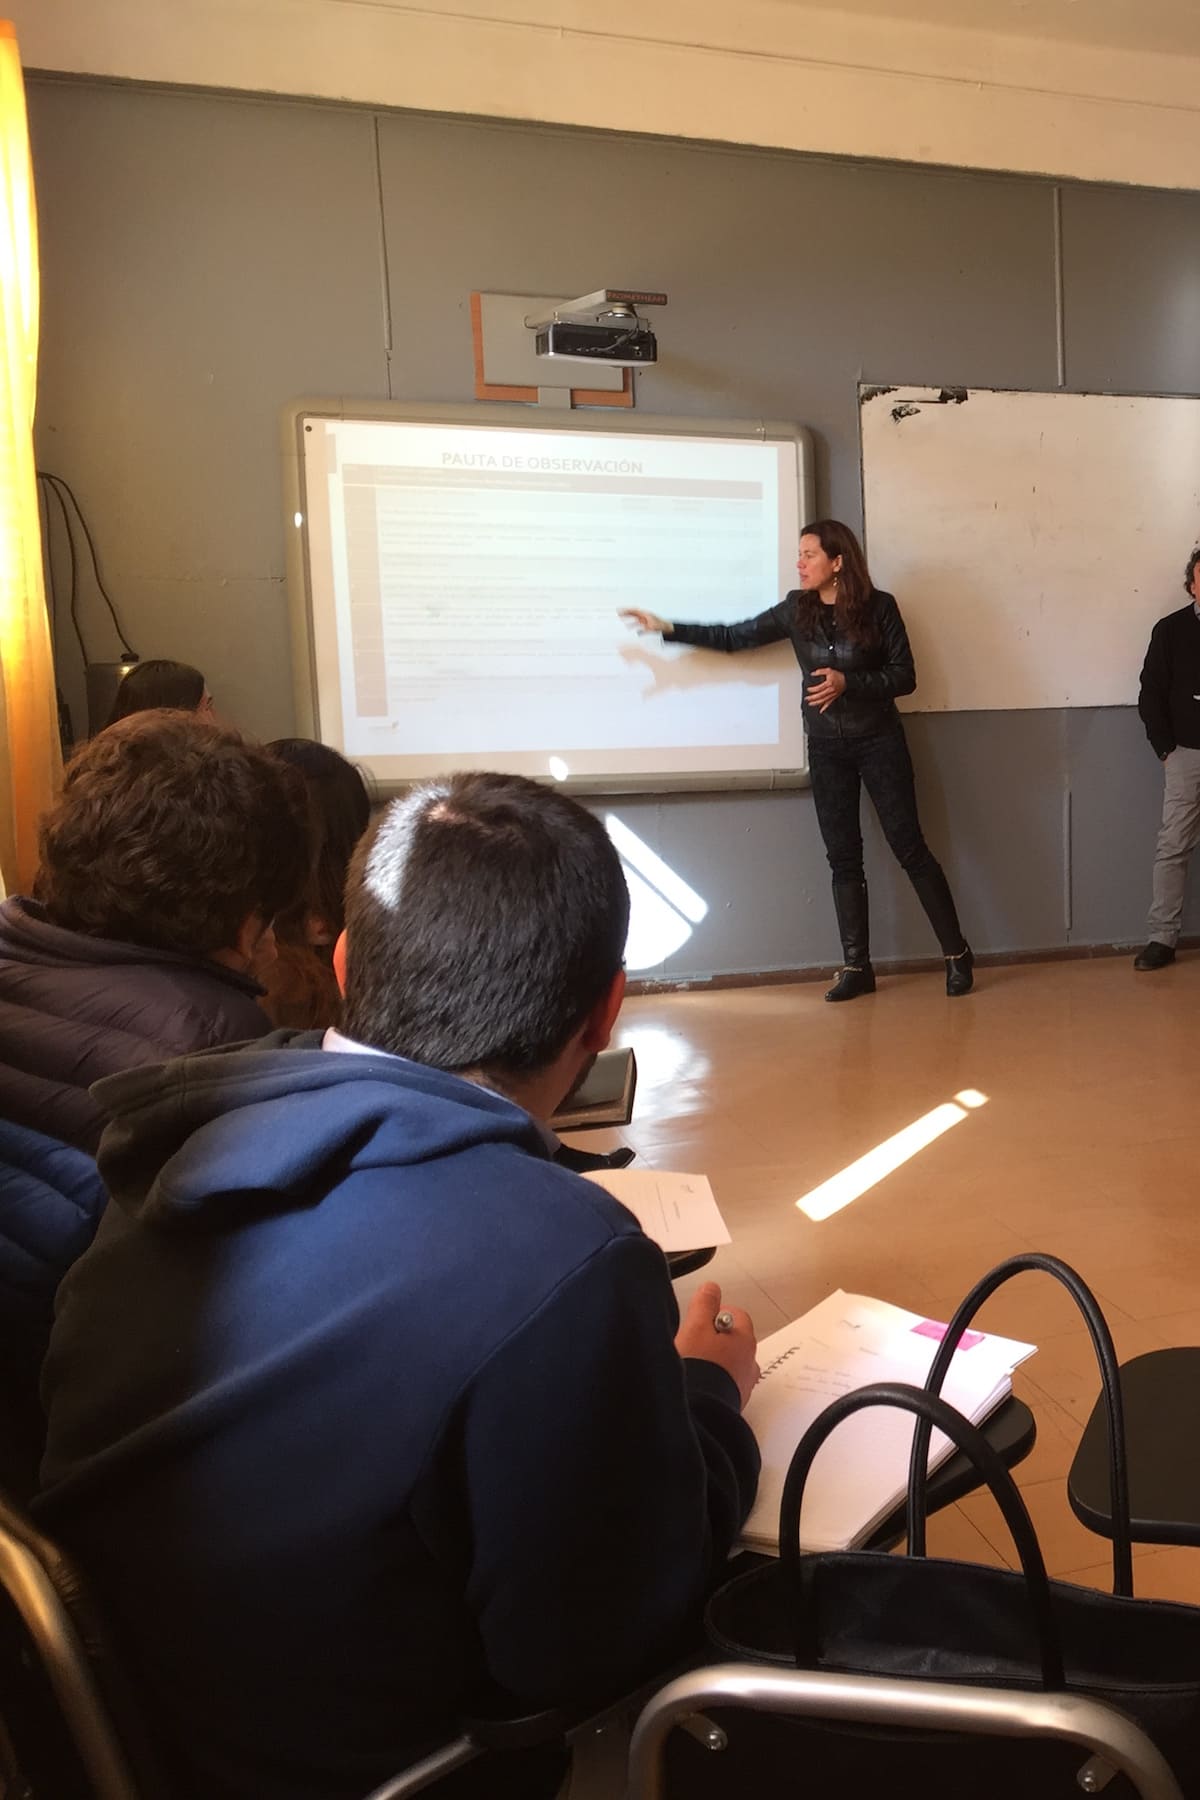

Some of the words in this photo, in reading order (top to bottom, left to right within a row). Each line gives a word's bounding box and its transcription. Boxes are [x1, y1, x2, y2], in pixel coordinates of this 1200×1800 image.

[442, 452, 497, 467] PAUTA
[502, 456, 523, 468] DE
[528, 457, 643, 474] OBSERVACIÓN
